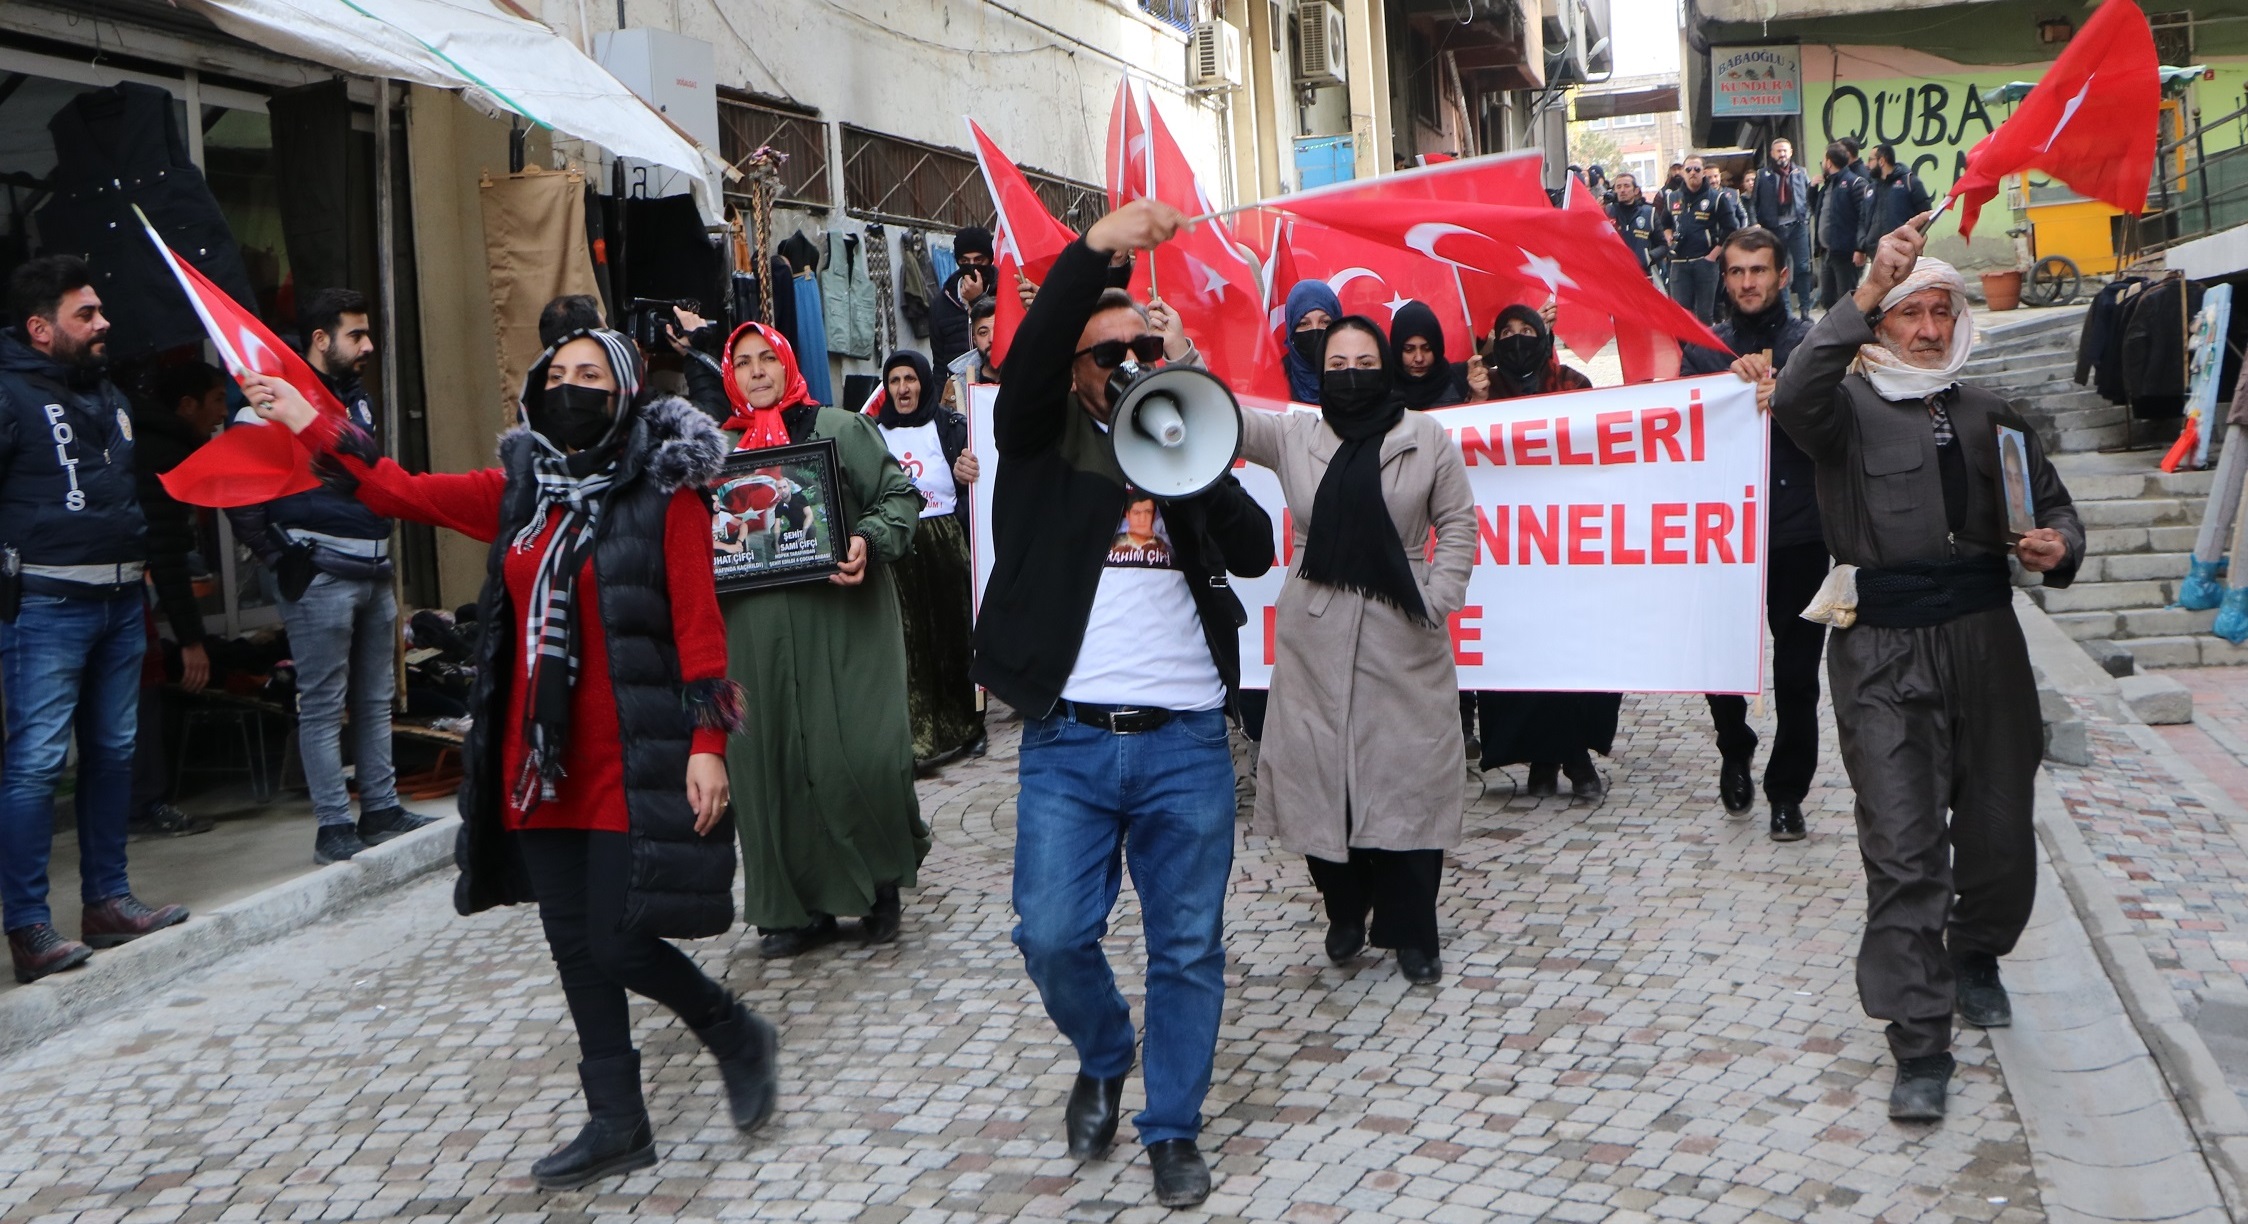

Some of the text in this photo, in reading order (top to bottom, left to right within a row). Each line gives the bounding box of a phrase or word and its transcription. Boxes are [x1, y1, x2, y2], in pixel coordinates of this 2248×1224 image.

[1719, 49, 1796, 75] BABAOĞLU 2
[1721, 80, 1793, 92] KUNDURA
[1446, 388, 1706, 467] NELERİ
[44, 403, 86, 511] POLİS
[1470, 485, 1757, 566] NNELERİ
[783, 528, 804, 541] ŞEHİT
[780, 537, 818, 551] SAMİ ÇİFÇİ
[733, 550, 755, 564] ÇİFÇİ
[1106, 547, 1144, 564] RAHİM
